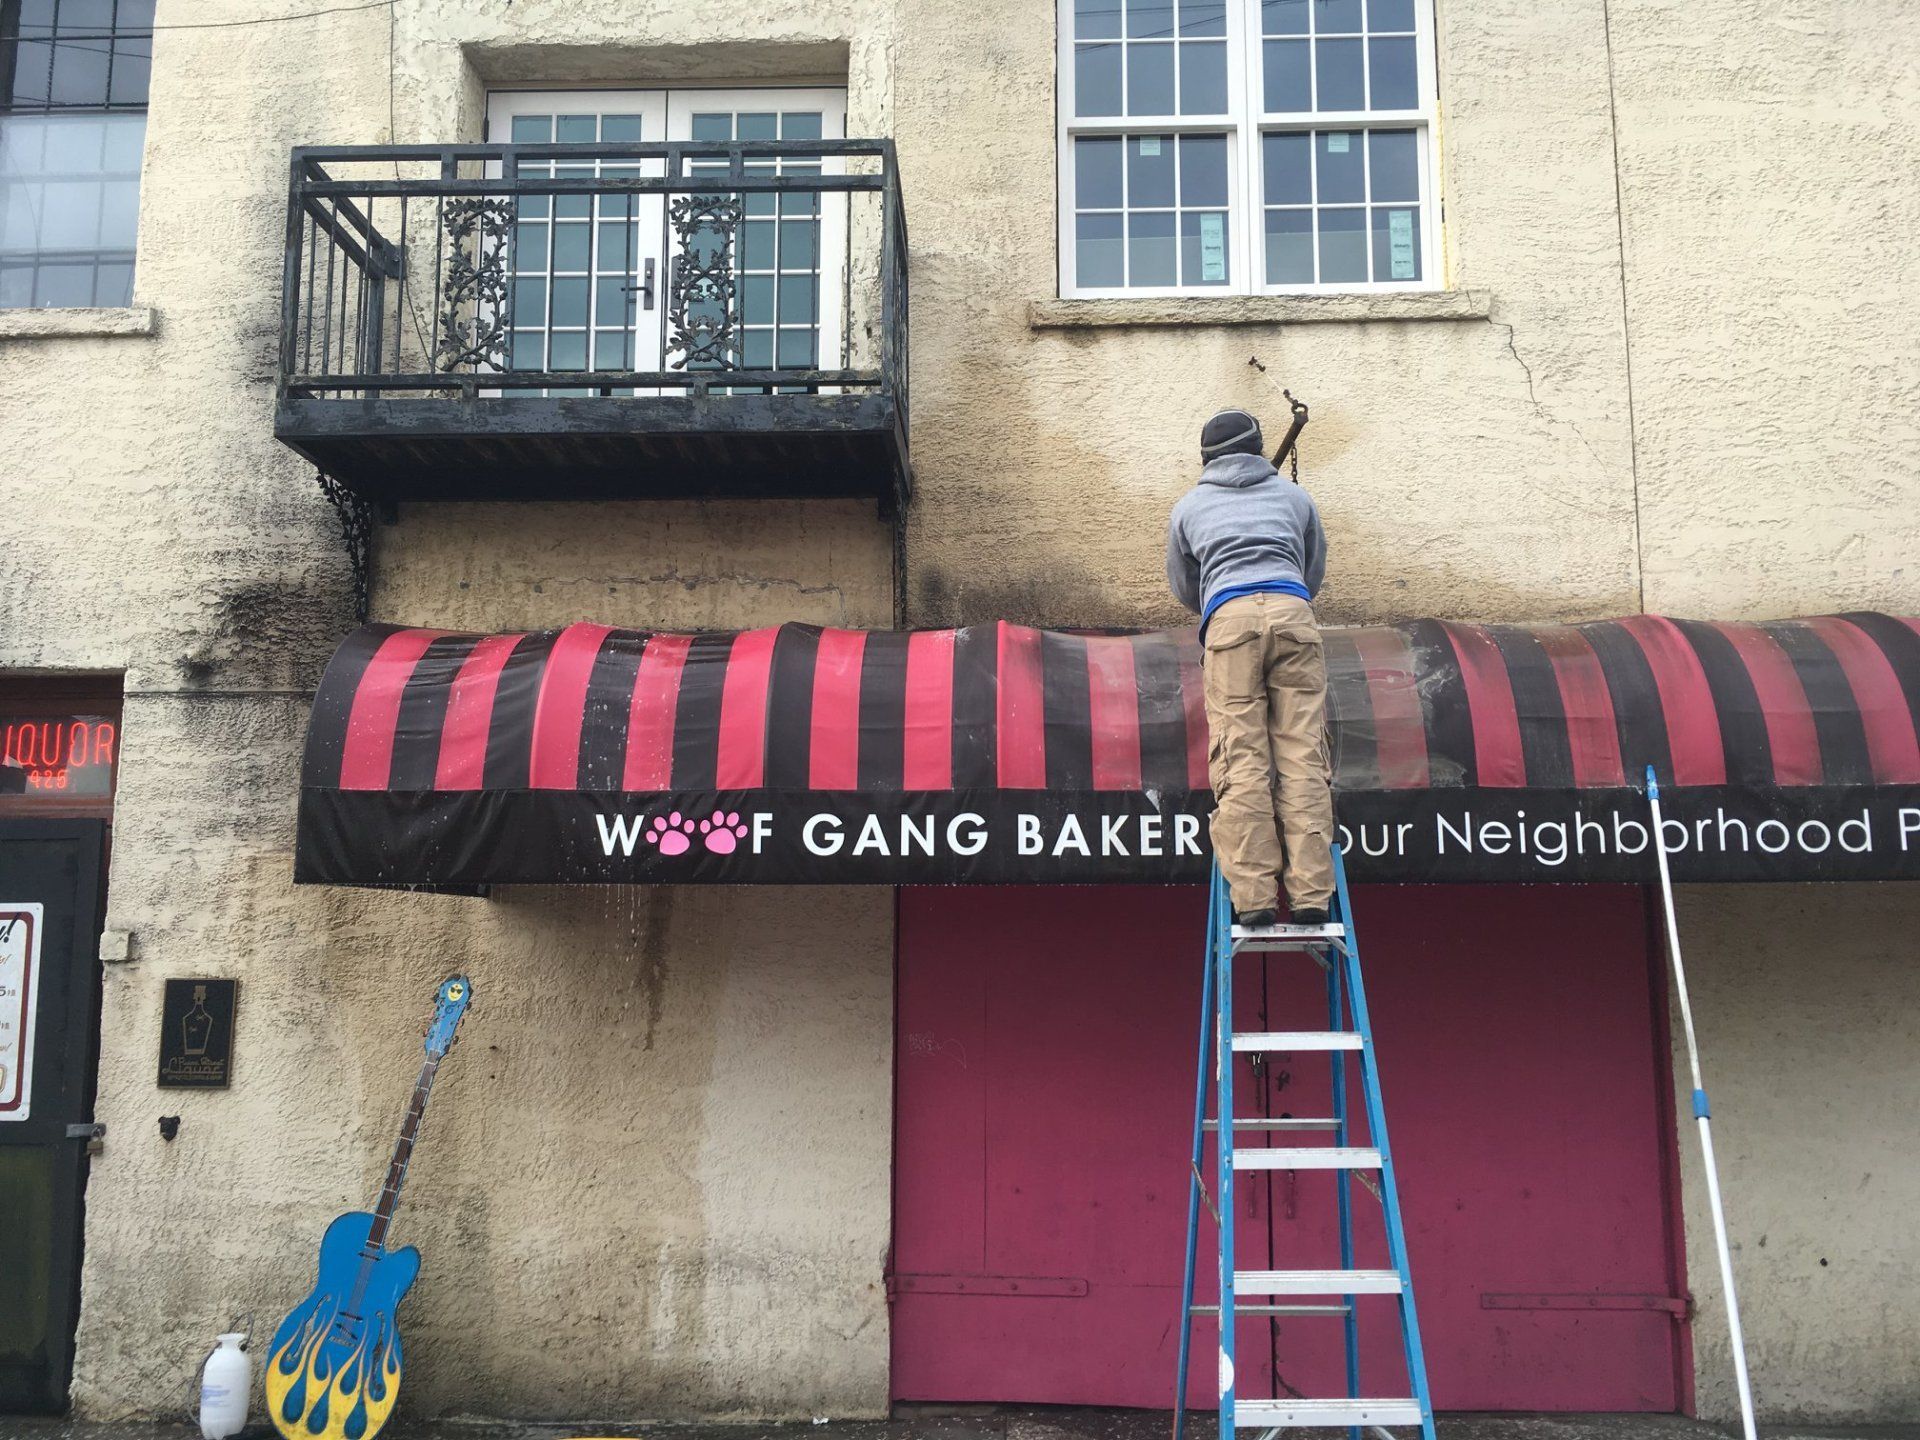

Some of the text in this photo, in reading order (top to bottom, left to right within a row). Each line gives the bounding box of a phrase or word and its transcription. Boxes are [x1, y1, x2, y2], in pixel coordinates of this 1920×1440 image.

[802, 813, 989, 857] GANG
[1017, 813, 1212, 857] BAKER
[1338, 823, 1414, 857] our
[1436, 807, 1874, 866] Neighborhood
